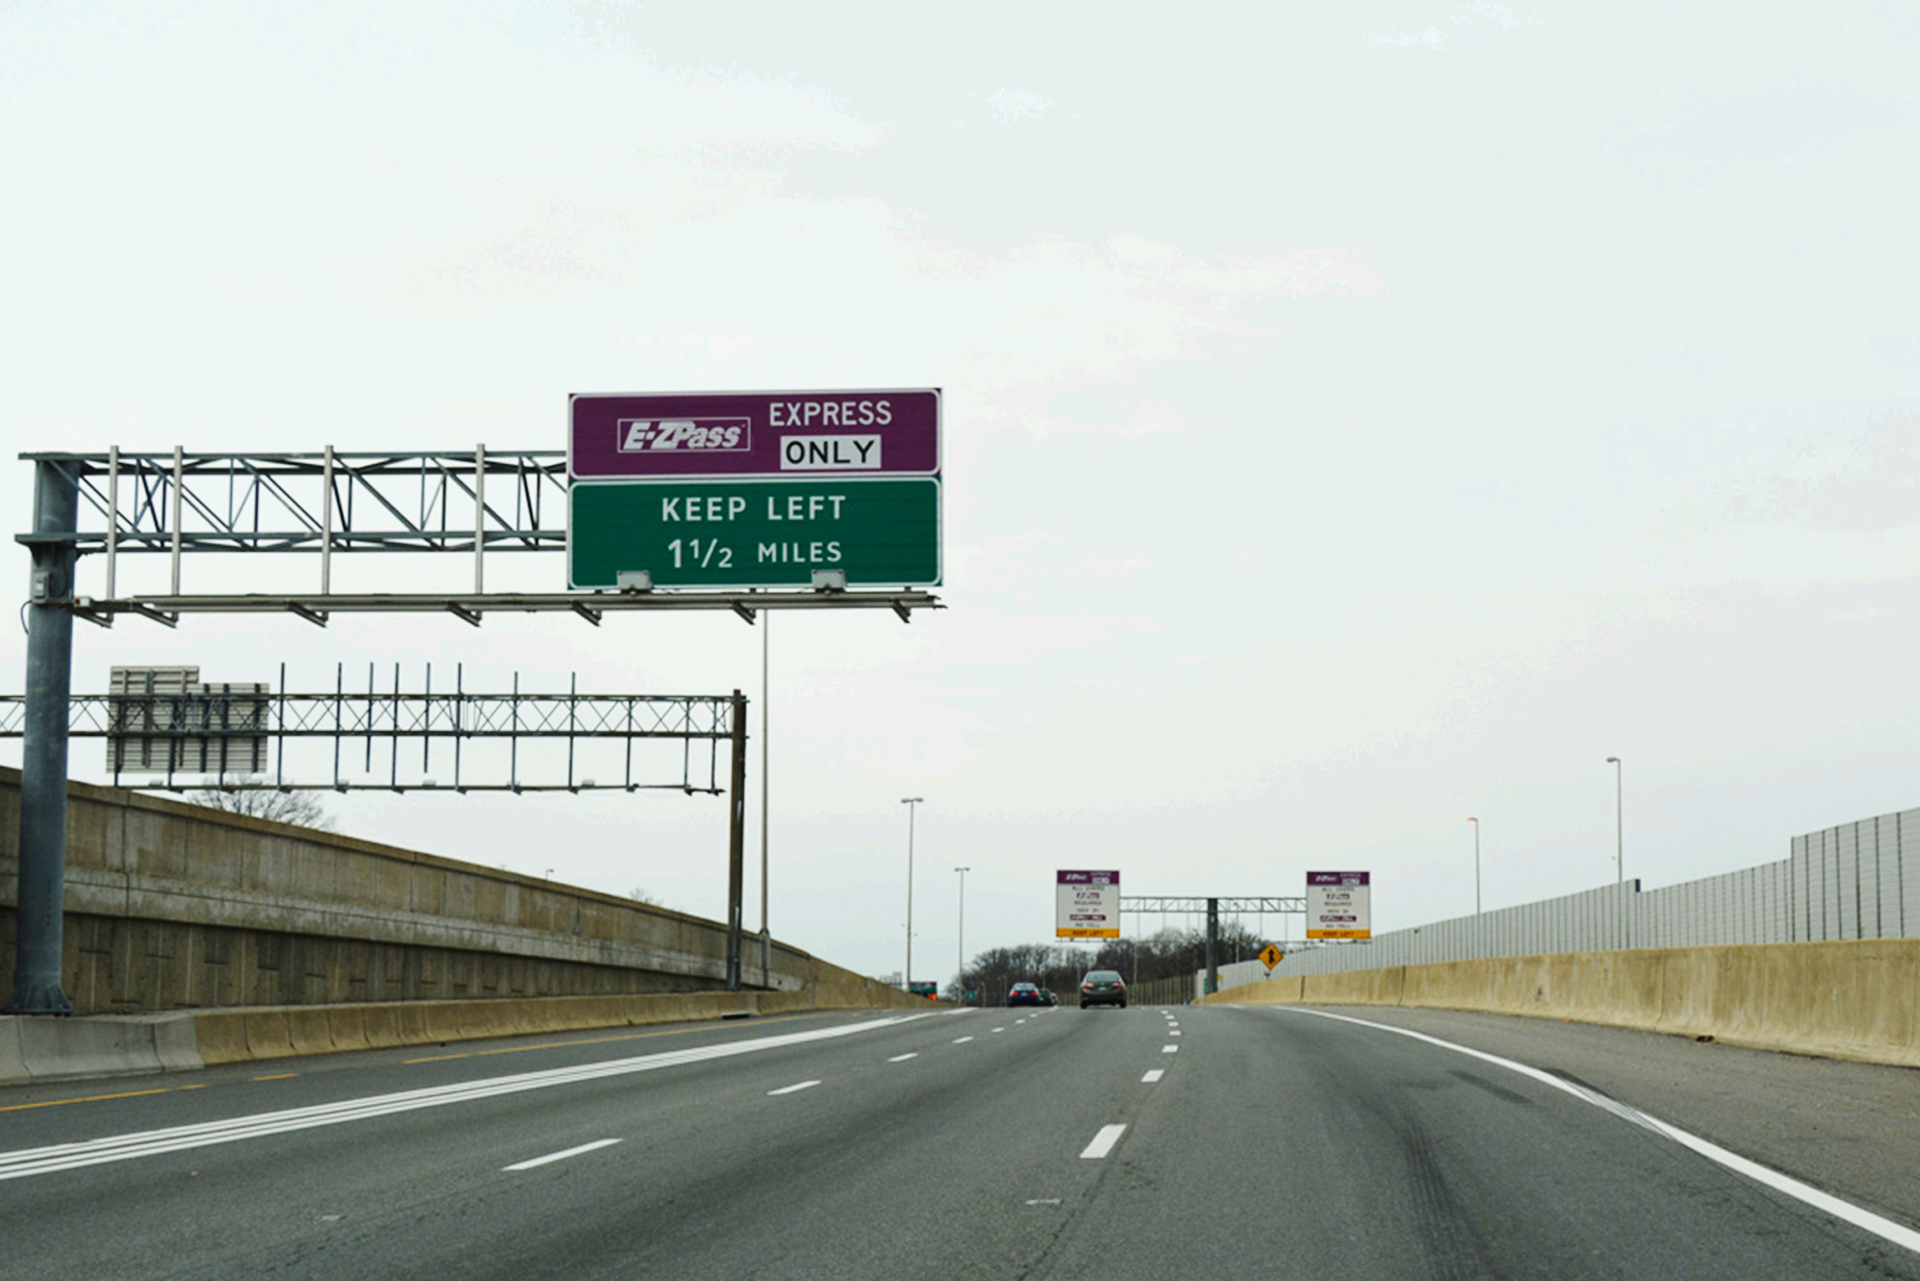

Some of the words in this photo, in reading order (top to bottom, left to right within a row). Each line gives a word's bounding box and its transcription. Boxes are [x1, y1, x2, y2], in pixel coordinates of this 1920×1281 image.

[770, 401, 892, 426] EXPRESS
[623, 421, 741, 449] E-ZPass
[786, 440, 875, 465] ONLY
[662, 496, 746, 521] KEEP
[768, 495, 846, 520] LEFT
[758, 541, 842, 563] MILES
